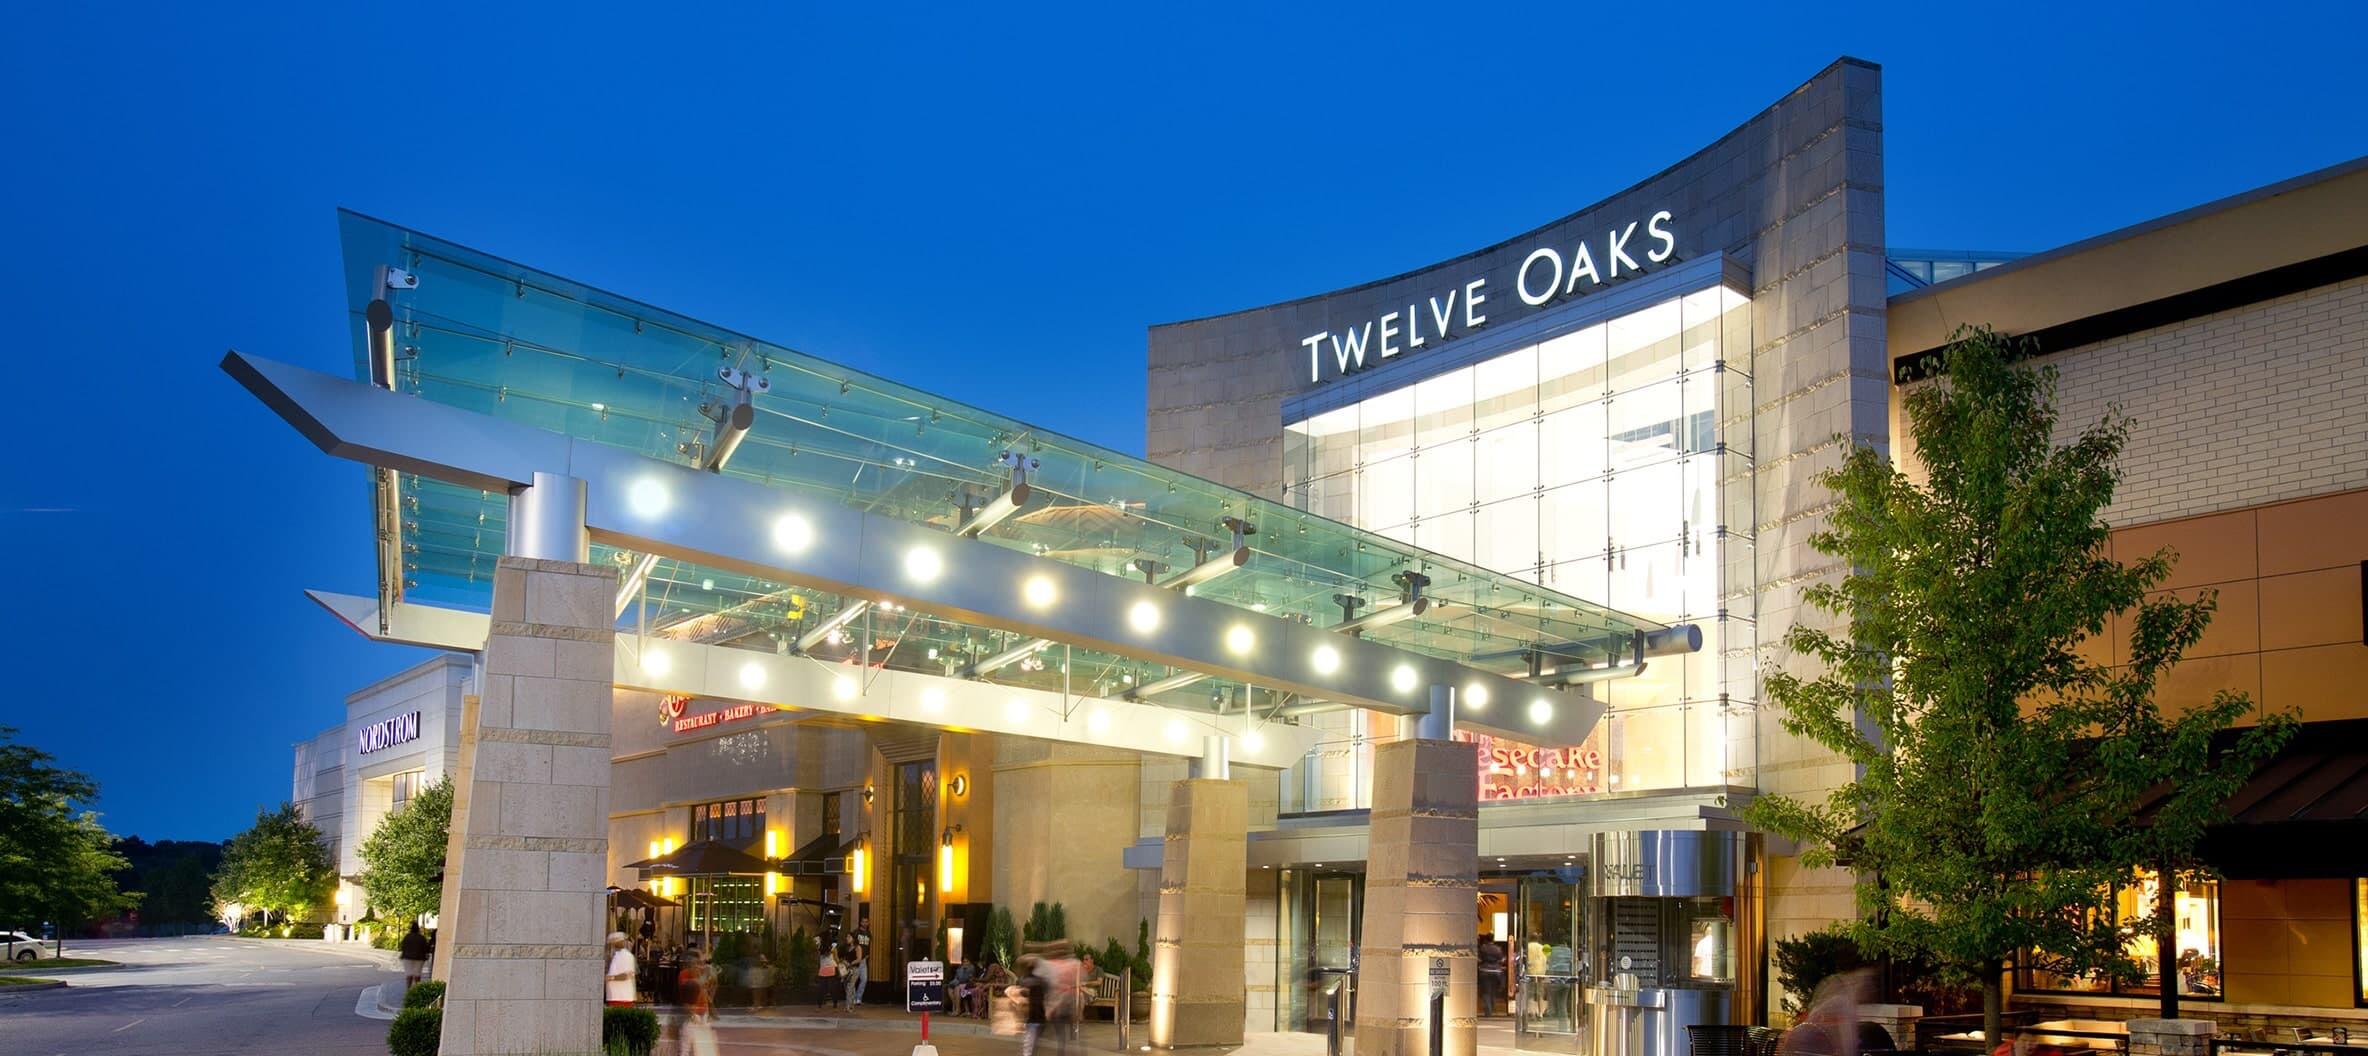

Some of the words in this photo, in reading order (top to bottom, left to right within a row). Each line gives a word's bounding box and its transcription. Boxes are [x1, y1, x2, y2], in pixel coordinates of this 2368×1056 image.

[1302, 279, 1486, 383] TWELVE
[1517, 210, 1676, 306] OAKS
[359, 711, 419, 754] NORDSTROM
[675, 712, 717, 732] RESTAURANT
[724, 704, 753, 721] BAKERY
[1604, 864, 1656, 880] VALET
